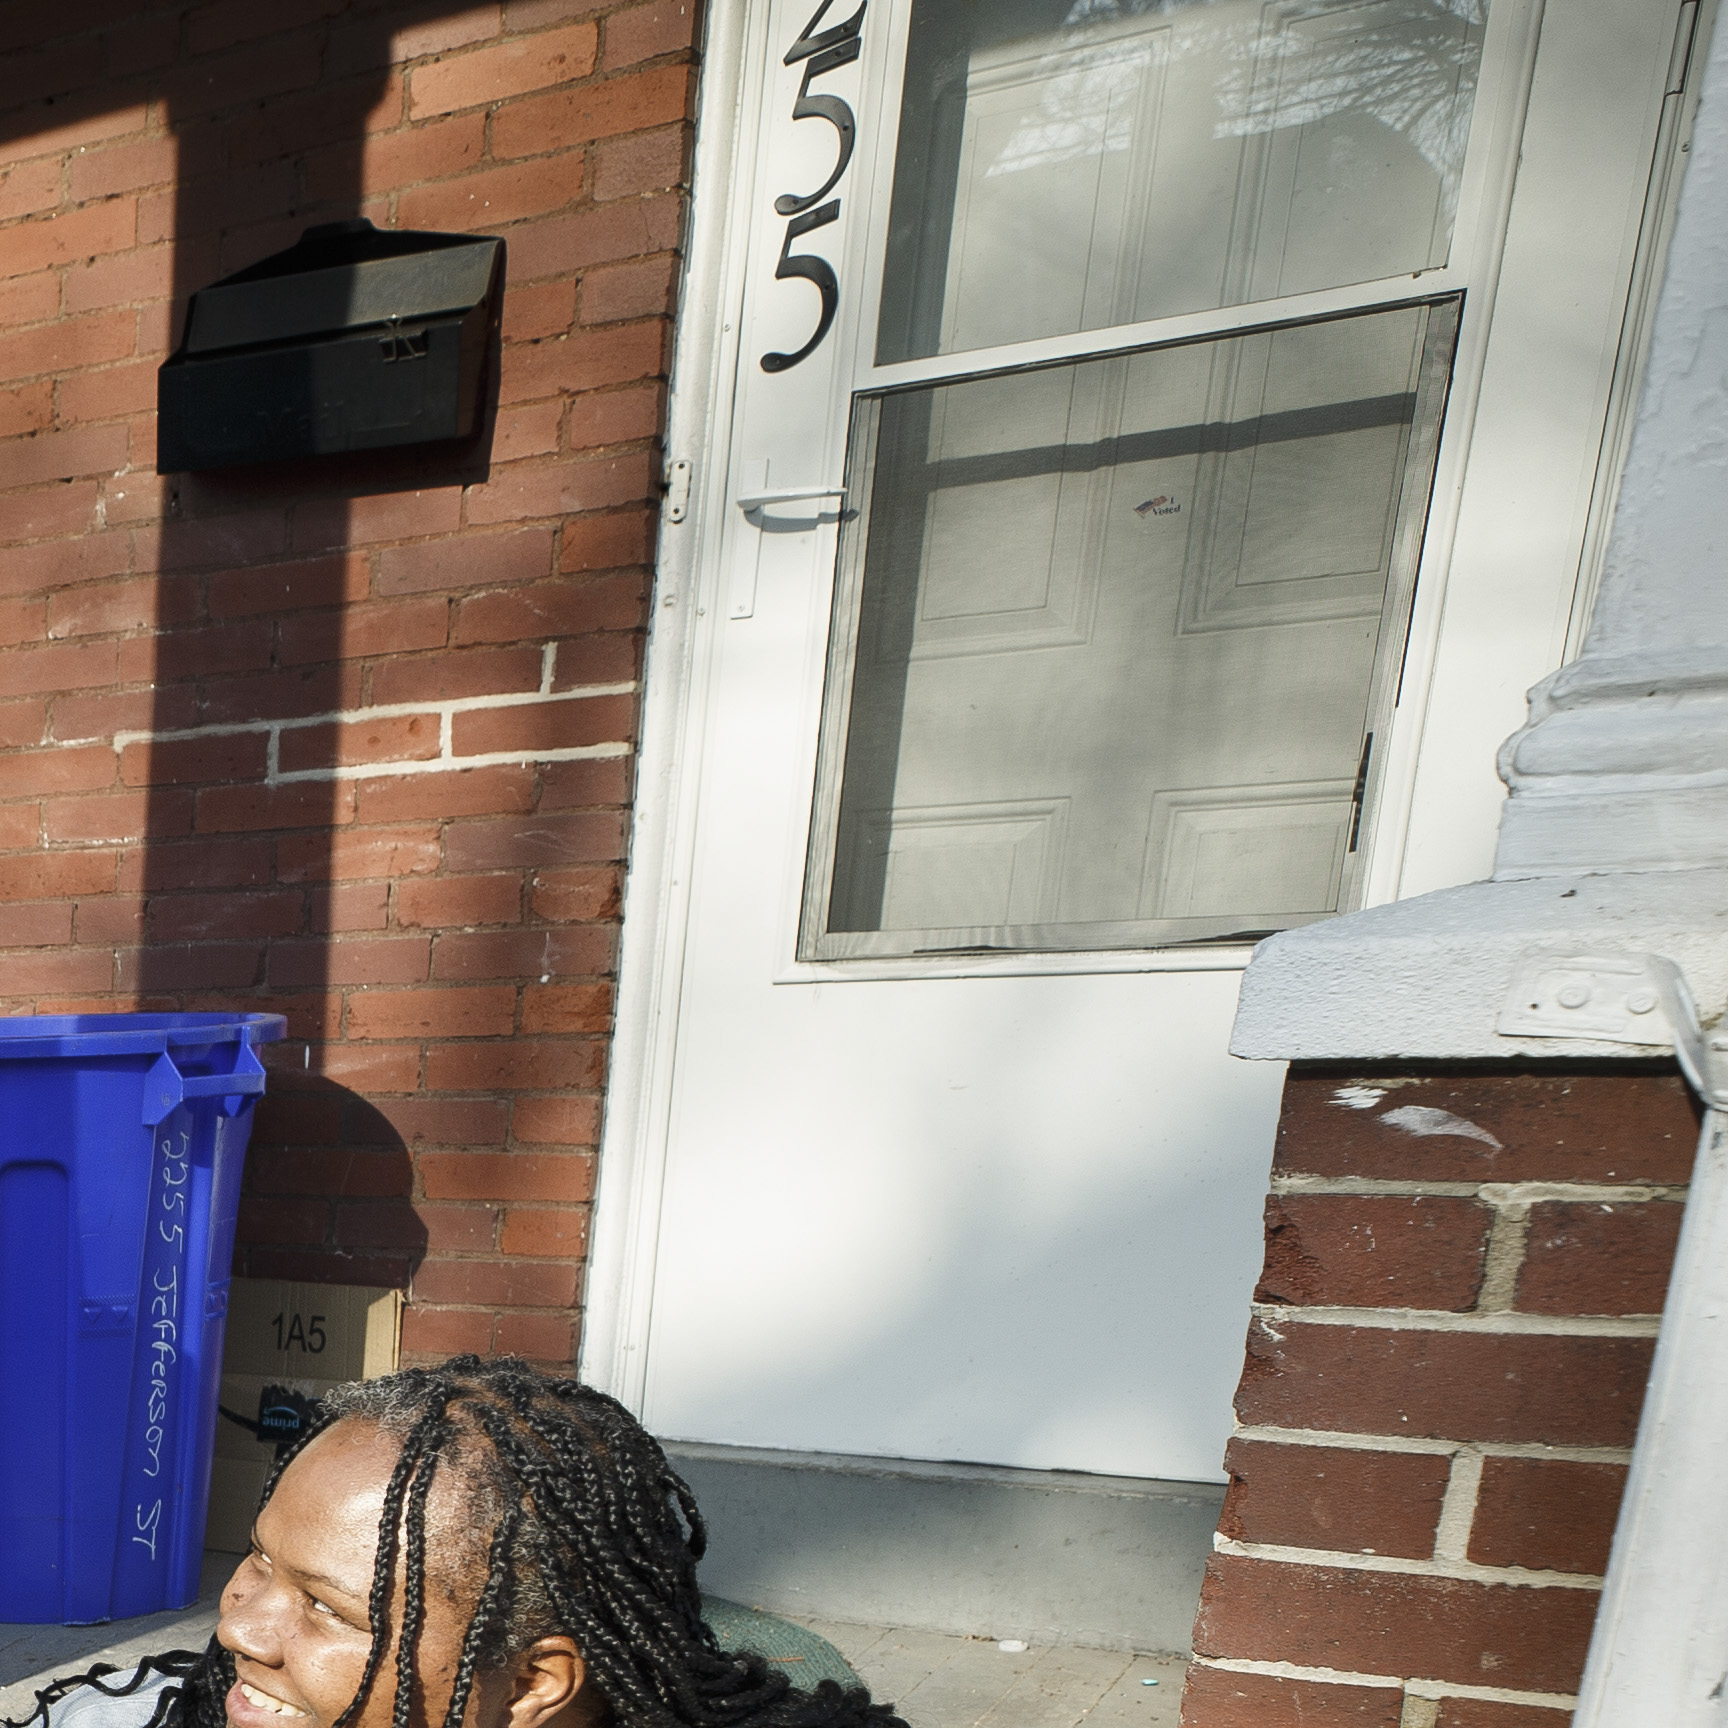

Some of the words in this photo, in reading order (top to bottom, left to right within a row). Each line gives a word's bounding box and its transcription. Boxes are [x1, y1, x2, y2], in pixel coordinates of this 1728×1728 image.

[160, 1132, 189, 1254] 2255
[271, 1312, 327, 1354] 1A5
[262, 1415, 300, 1431] prime
